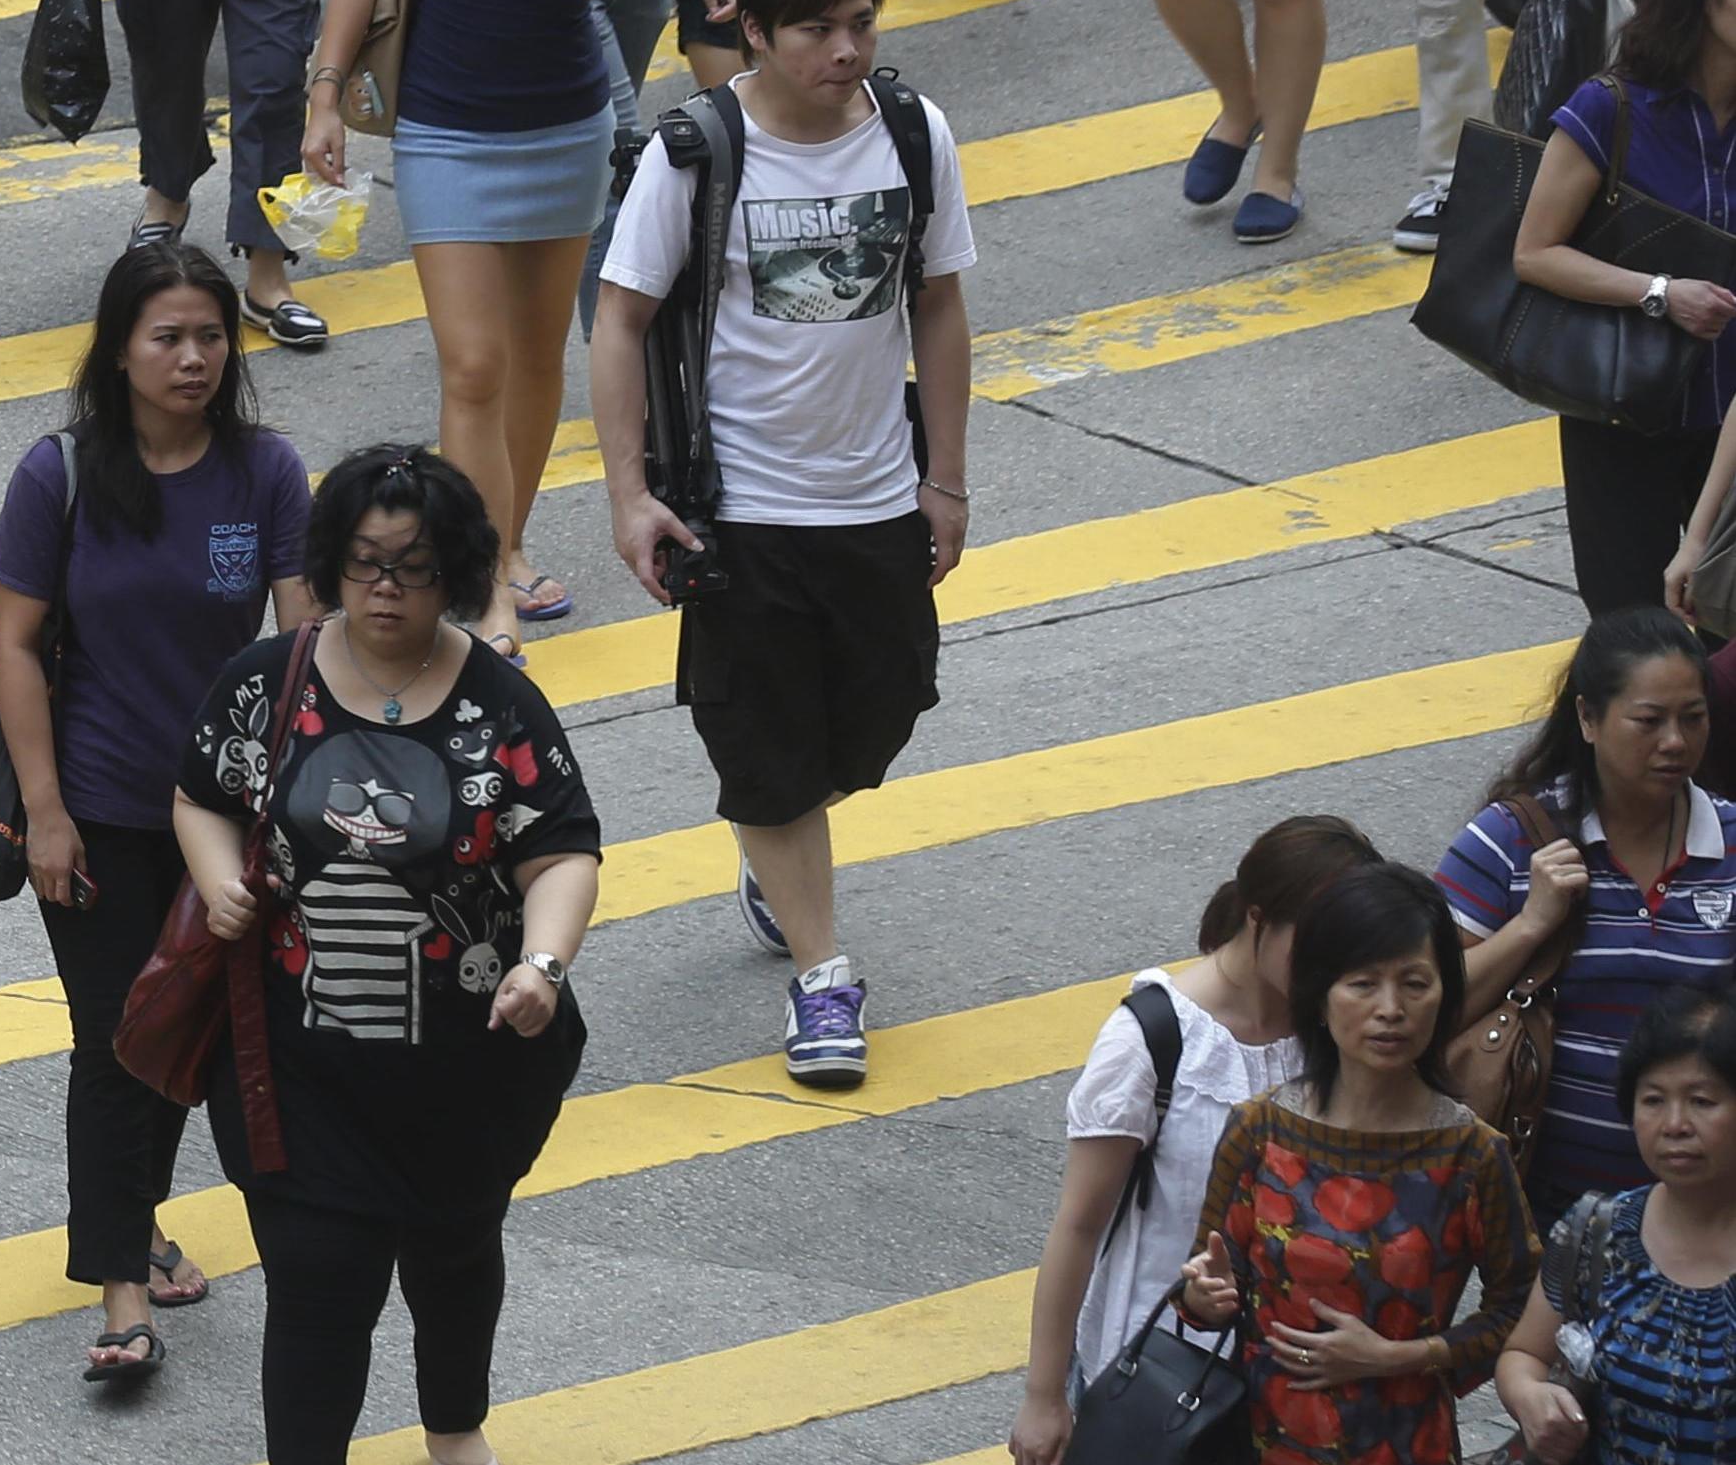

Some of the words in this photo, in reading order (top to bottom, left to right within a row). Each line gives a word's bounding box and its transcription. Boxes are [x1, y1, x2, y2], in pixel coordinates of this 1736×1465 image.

[748, 201, 859, 240] Music.
[211, 523, 258, 535] COACH
[235, 674, 265, 708] MJ
